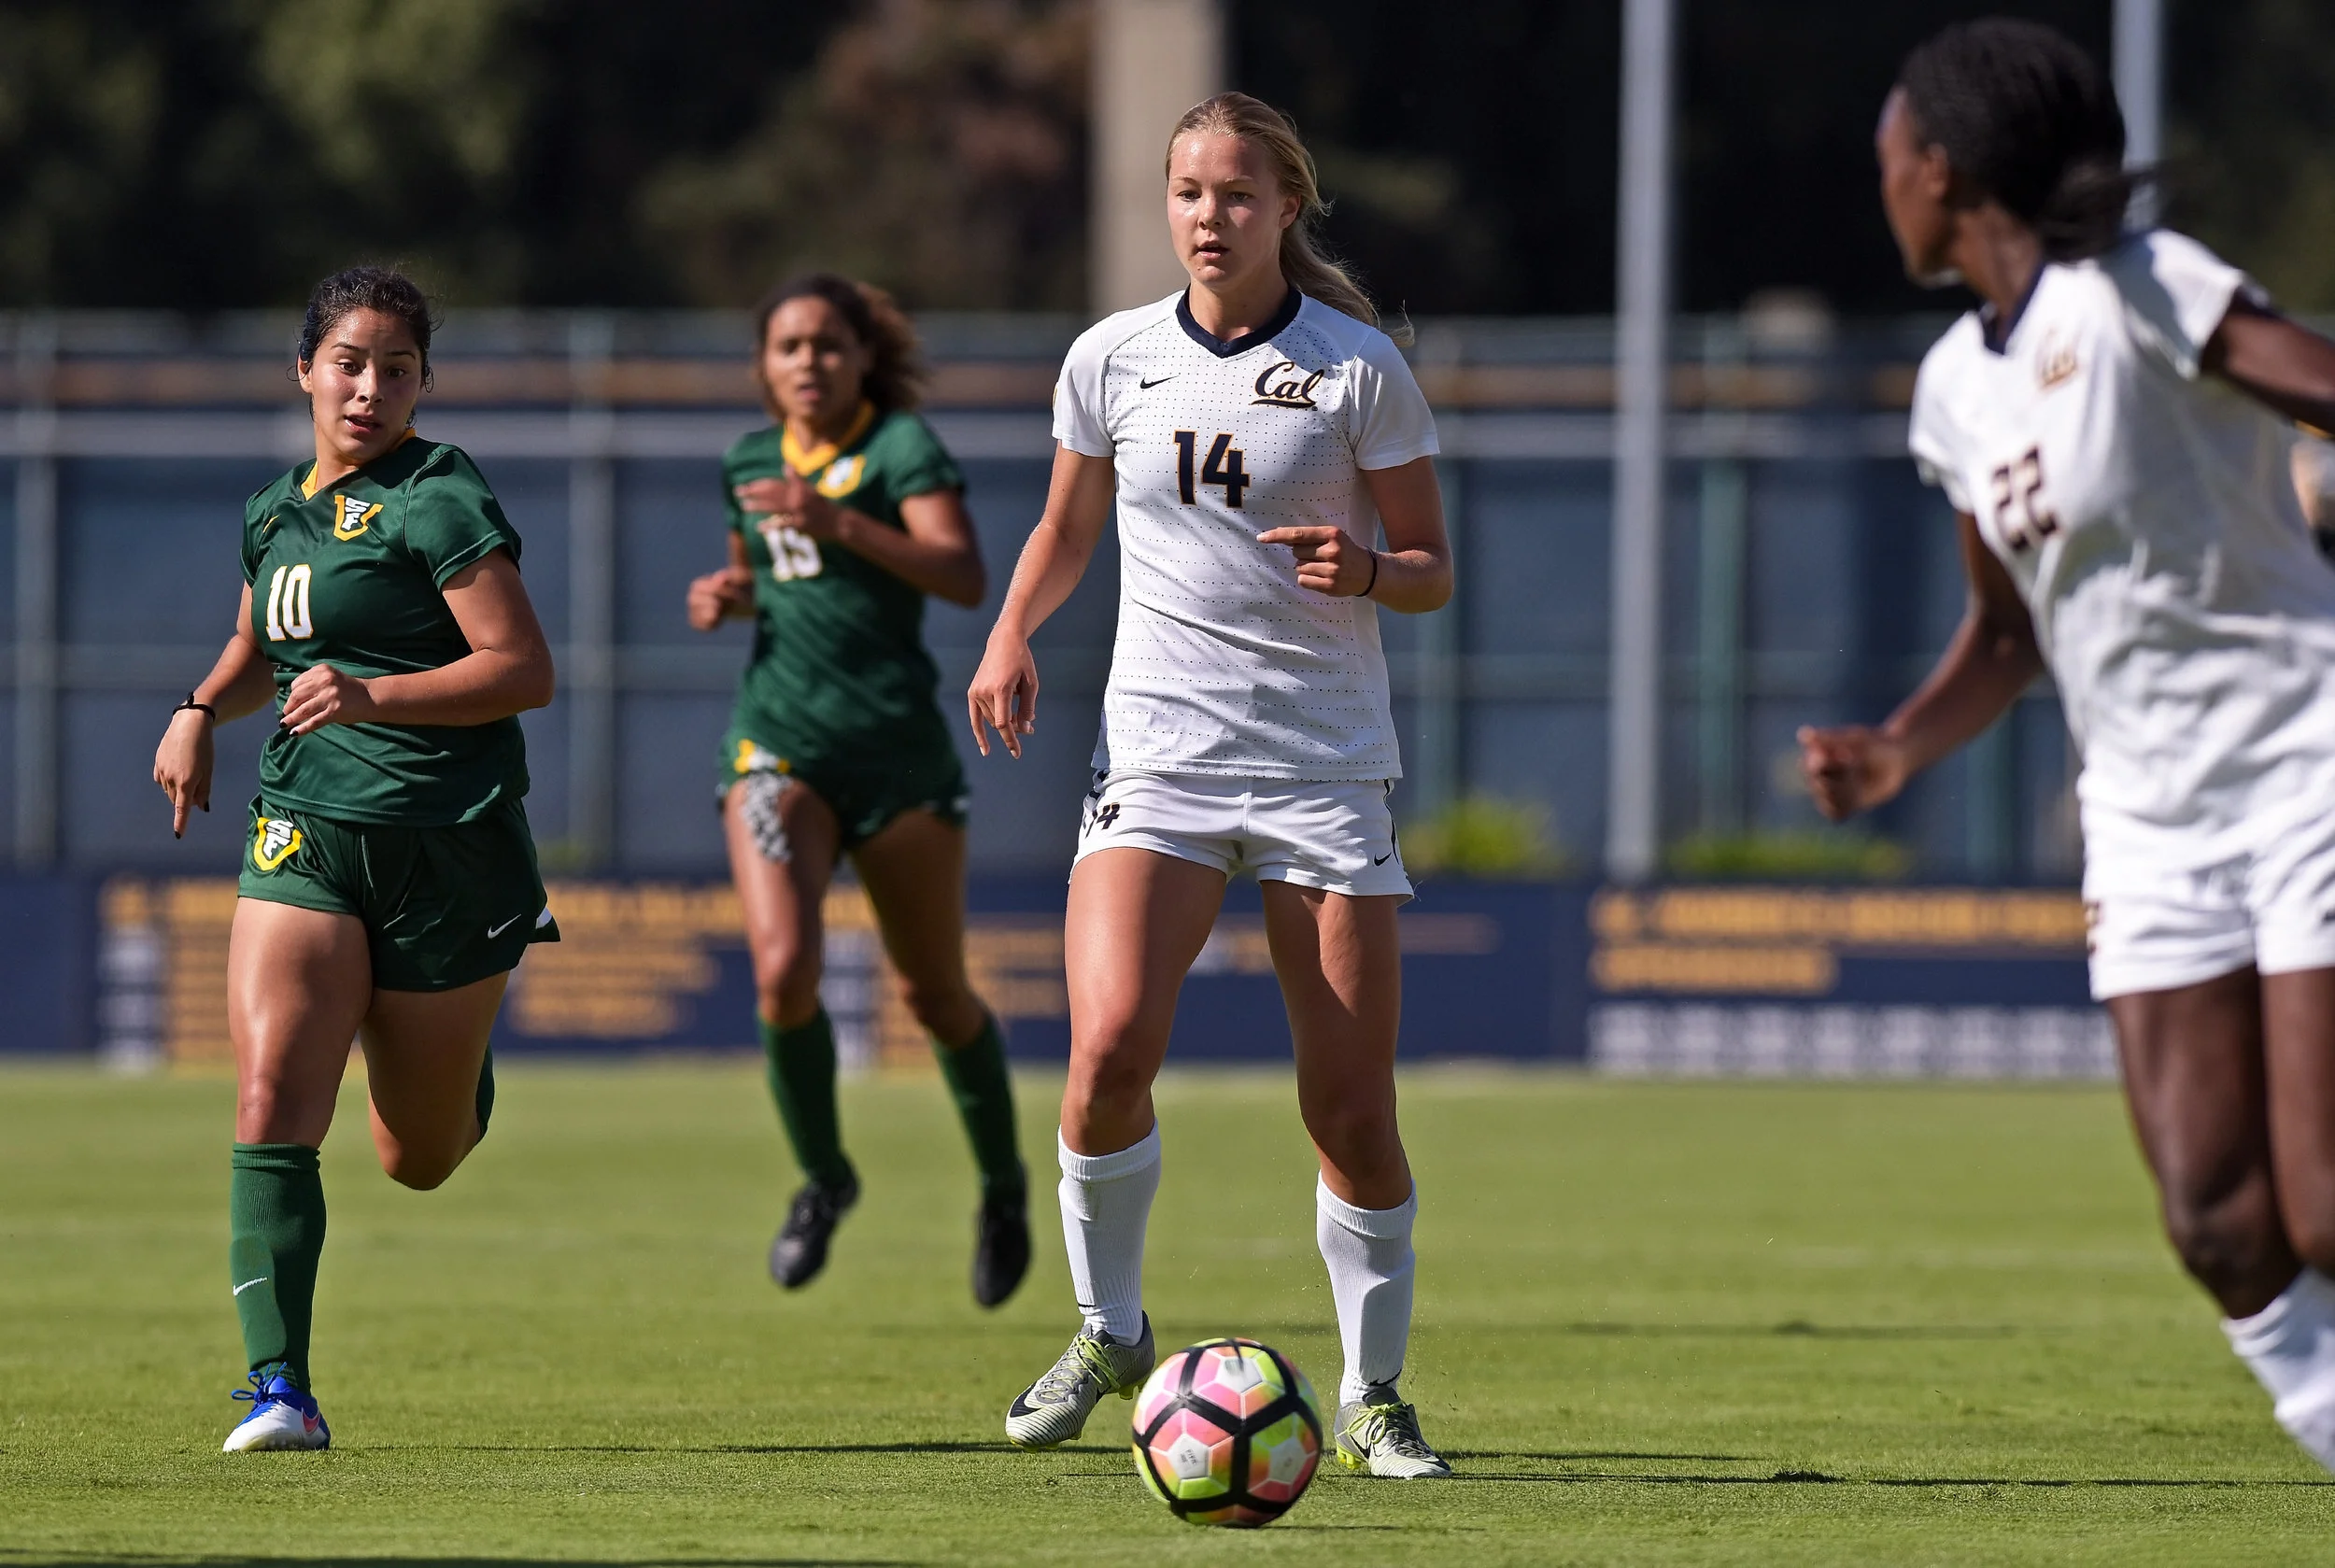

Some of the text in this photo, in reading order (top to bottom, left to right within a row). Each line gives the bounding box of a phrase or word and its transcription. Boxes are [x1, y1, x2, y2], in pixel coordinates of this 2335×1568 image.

[1252, 361, 1324, 408] Cal
[1172, 429, 1251, 509] 14
[1991, 445, 2059, 551] 22
[265, 563, 314, 642] 10
